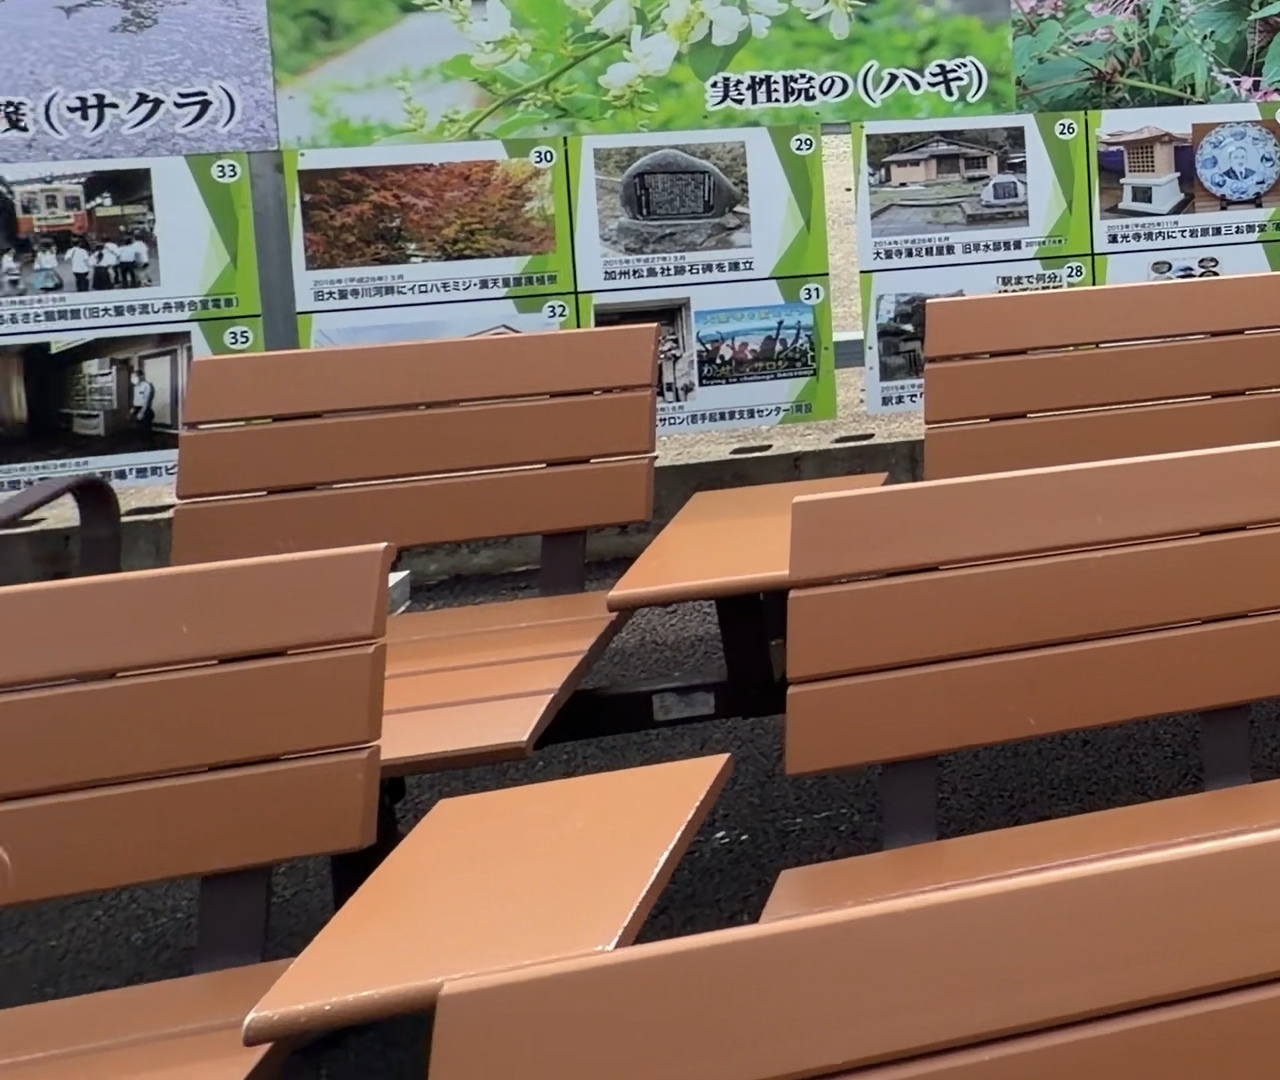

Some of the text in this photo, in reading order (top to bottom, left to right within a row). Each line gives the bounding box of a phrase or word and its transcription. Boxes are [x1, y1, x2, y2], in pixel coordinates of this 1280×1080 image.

[1058, 123, 1075, 135] 26
[795, 138, 813, 151] 29
[533, 150, 554, 164] 30
[216, 164, 238, 179] 33
[603, 260, 755, 281] 加州松島社跡石碑を建立
[1066, 265, 1083, 278] 28
[804, 287, 820, 299] 31
[547, 305, 567, 318] 32
[228, 330, 250, 345] 35
